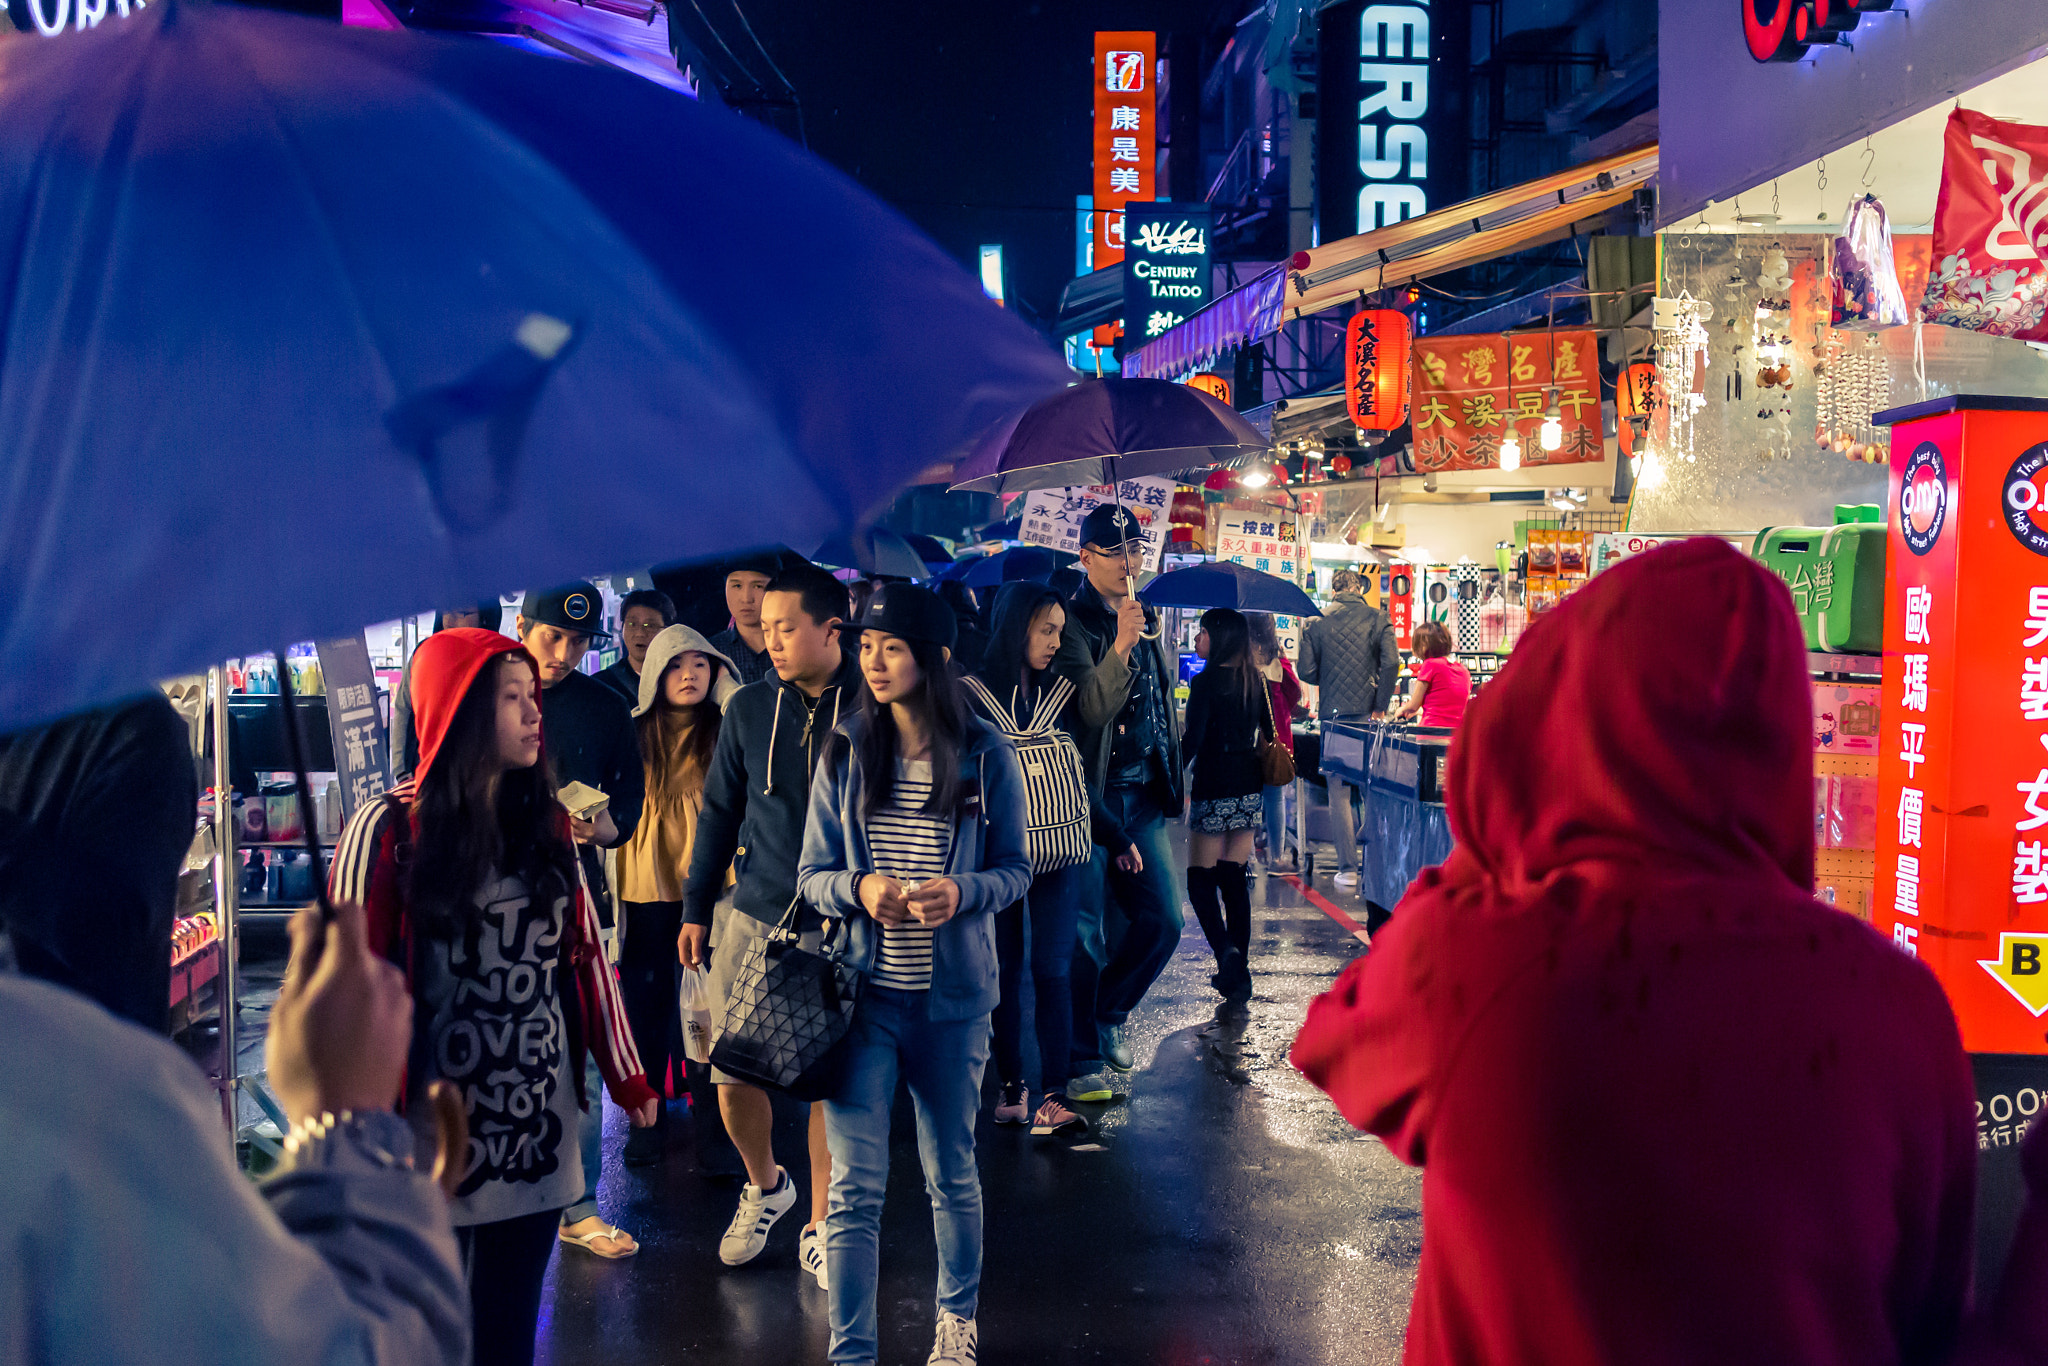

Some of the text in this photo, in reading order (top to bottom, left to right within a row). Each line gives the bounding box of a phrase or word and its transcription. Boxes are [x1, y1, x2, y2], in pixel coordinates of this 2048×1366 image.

[1358, 0, 1430, 235] ERSE
[1110, 105, 1141, 193] 康是美
[1134, 260, 1197, 278] CENTURY
[1149, 280, 1202, 297] TATTOO
[1146, 311, 1184, 336] 刺
[1353, 318, 1380, 416] 大溪名產
[1420, 340, 1583, 387] 台灣名產
[1416, 389, 1598, 431] 大溪豆干
[2016, 459, 2040, 477] The
[2012, 511, 2030, 536] High
[456, 958, 558, 1005] NOT
[437, 1016, 557, 1079] OVER
[467, 1078, 548, 1120] NOT
